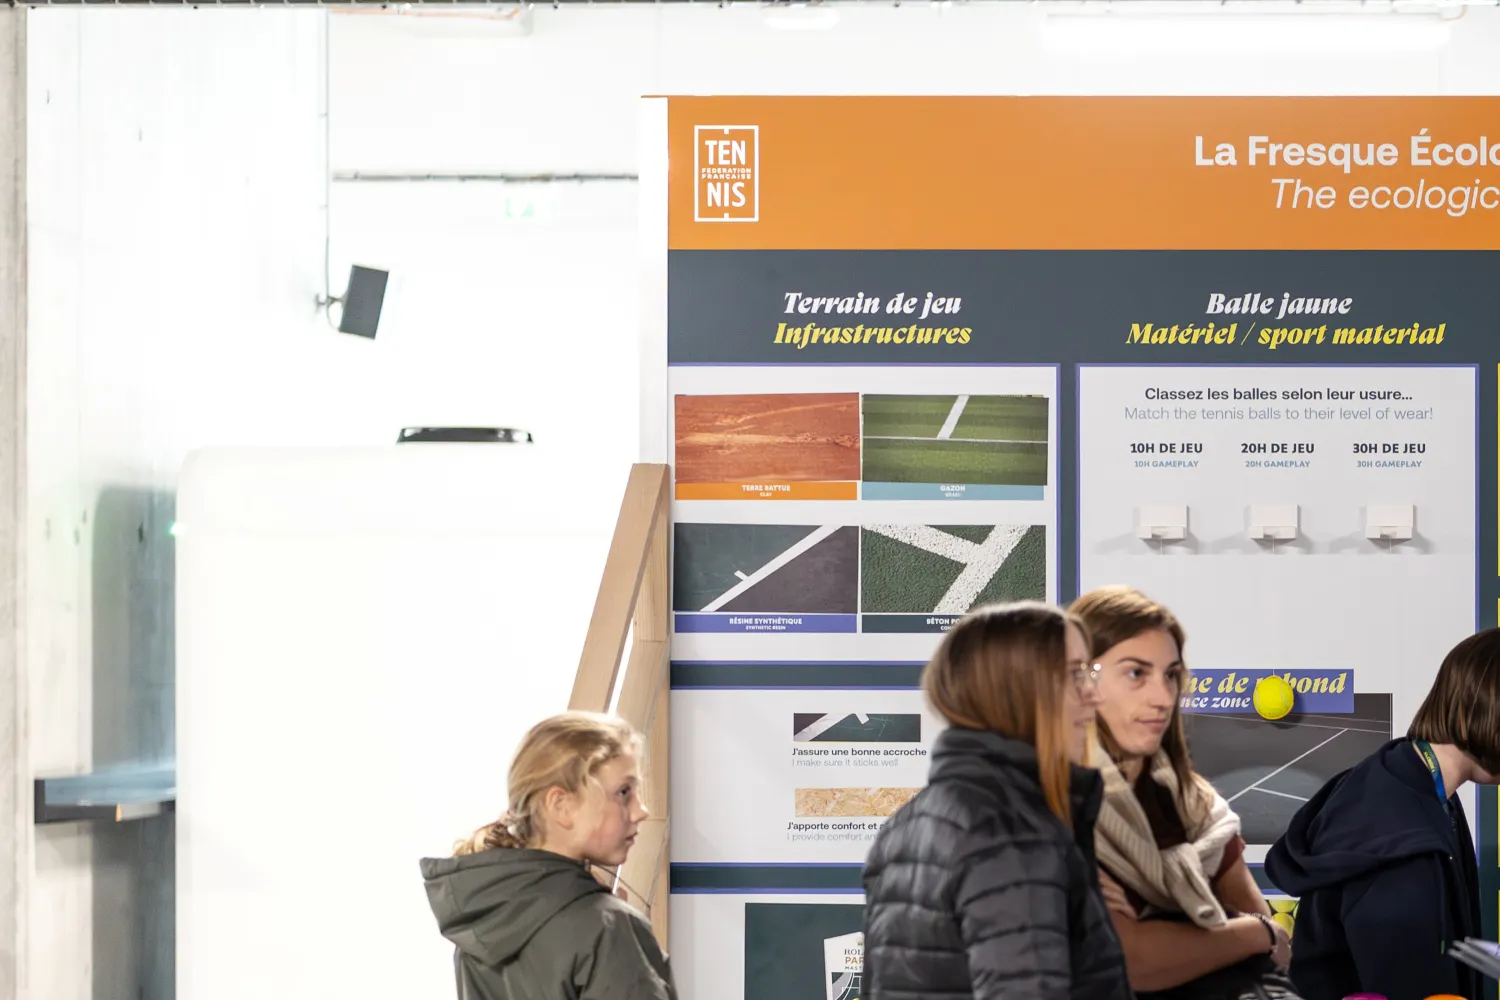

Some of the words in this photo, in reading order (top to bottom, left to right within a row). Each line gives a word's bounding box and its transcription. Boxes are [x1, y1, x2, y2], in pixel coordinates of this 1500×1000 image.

[705, 140, 746, 165] TEN
[1195, 135, 1238, 167] La
[1248, 135, 1399, 174] Fresque
[706, 182, 746, 207] NIS
[1271, 178, 1337, 210] The
[784, 292, 881, 314] Terrain
[886, 292, 917, 315] de
[919, 292, 962, 320] jeu
[1206, 292, 1274, 315] Balle
[1277, 292, 1353, 320] jaune
[774, 322, 972, 349] Infrastructures
[1126, 322, 1239, 346] Matériel
[1257, 325, 1328, 349] sport
[1332, 322, 1446, 345] material
[1144, 387, 1204, 400] Classez
[1207, 387, 1230, 400] les
[1233, 387, 1278, 400] balles
[1281, 387, 1323, 400] selon
[1326, 387, 1356, 401] leur
[1124, 406, 1170, 420] Match
[1173, 406, 1197, 420] the
[1201, 406, 1244, 420] tennis
[1248, 406, 1282, 420] balls
[1285, 408, 1300, 420] to
[1303, 407, 1335, 420] their
[1339, 407, 1371, 420] level
[1375, 406, 1391, 420] of
[1393, 407, 1433, 420] wear!
[1130, 442, 1155, 454] 10H
[1159, 442, 1177, 454] DE
[1179, 442, 1203, 454] JEU
[1240, 442, 1267, 454] 20H
[1270, 443, 1288, 454] DE
[1291, 443, 1315, 454] JEU
[1352, 443, 1378, 454] 30H
[1382, 443, 1400, 454] DE
[1402, 443, 1426, 454] JEU
[1134, 460, 1150, 468] 10H
[1151, 460, 1199, 468] GAMEPLAY
[1245, 460, 1262, 468] 20H
[1263, 460, 1311, 468] GAMEPLAY
[1356, 460, 1373, 468] 30H
[1374, 460, 1423, 468] GAMEPLAY
[940, 484, 966, 492] GAZON
[926, 617, 950, 625] BÉTON
[1217, 672, 1250, 694] de
[1211, 697, 1251, 708] zone
[851, 747, 881, 756] bonne
[883, 747, 927, 756] accroche
[796, 757, 822, 767] make
[823, 759, 844, 767] sure
[853, 758, 879, 768] sticks
[831, 822, 865, 831] confort
[868, 823, 877, 831] et
[792, 833, 825, 844] provide
[828, 833, 862, 842] comfort
